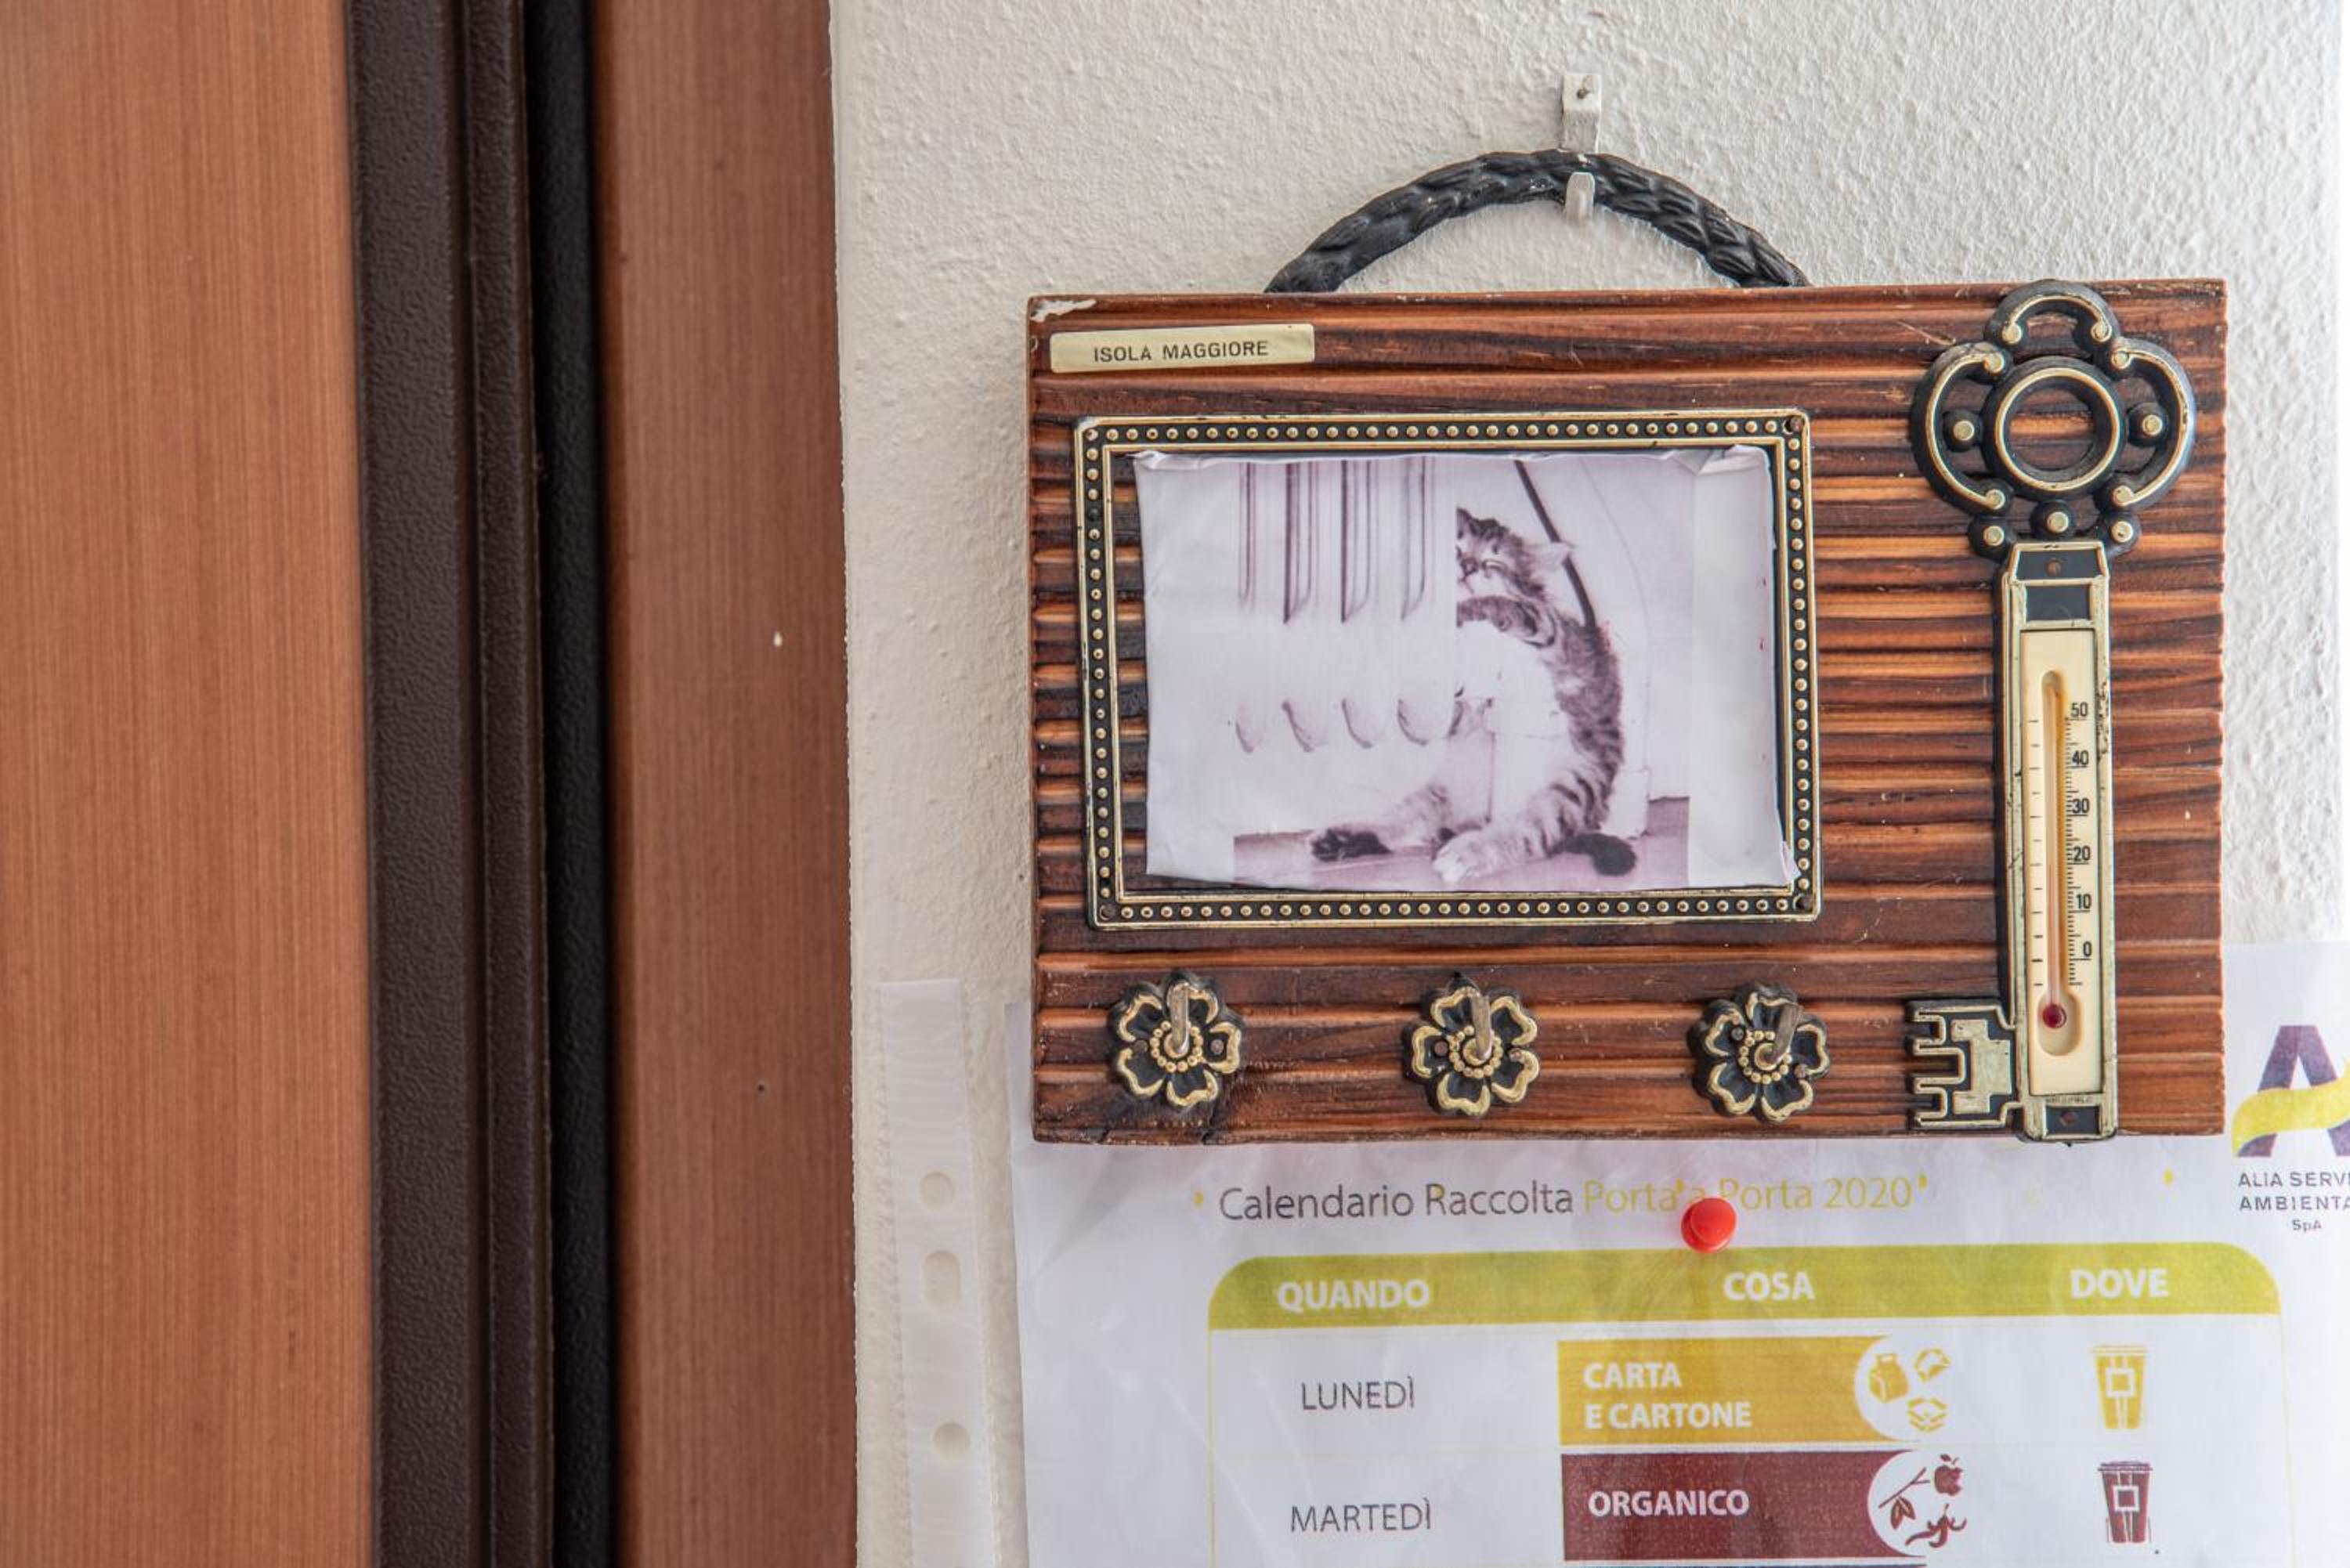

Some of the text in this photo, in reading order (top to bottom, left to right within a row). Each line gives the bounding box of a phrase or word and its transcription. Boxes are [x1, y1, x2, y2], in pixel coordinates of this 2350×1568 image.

[1094, 340, 1269, 363] ISOLA MAGGIORE
[2070, 702, 2088, 718] 50
[2071, 750, 2089, 767] 40
[2072, 798, 2090, 815] 30
[2073, 846, 2092, 862] 20
[2076, 894, 2092, 910] 10
[2082, 941, 2092, 958] 0
[2238, 1172, 2283, 1187] ALIA
[1219, 1185, 1414, 1221] Calendario
[1425, 1180, 1574, 1217] Raccolta
[1584, 1178, 1677, 1213] Porta
[1719, 1176, 1813, 1211] Porta
[1824, 1176, 1912, 1209] 2020
[2291, 1219, 2322, 1232] SpA
[1276, 1278, 1432, 1313] QUANDO
[1723, 1271, 1816, 1302] COSA
[2069, 1268, 2170, 1300] DOVE
[1582, 1361, 1683, 1390] CARTA
[1300, 1375, 1415, 1411] LUNEDÌ
[1585, 1401, 1753, 1430] E CARTONE
[1290, 1497, 1432, 1533] MARTEDÌ
[1587, 1488, 1752, 1519] ORGANICO
